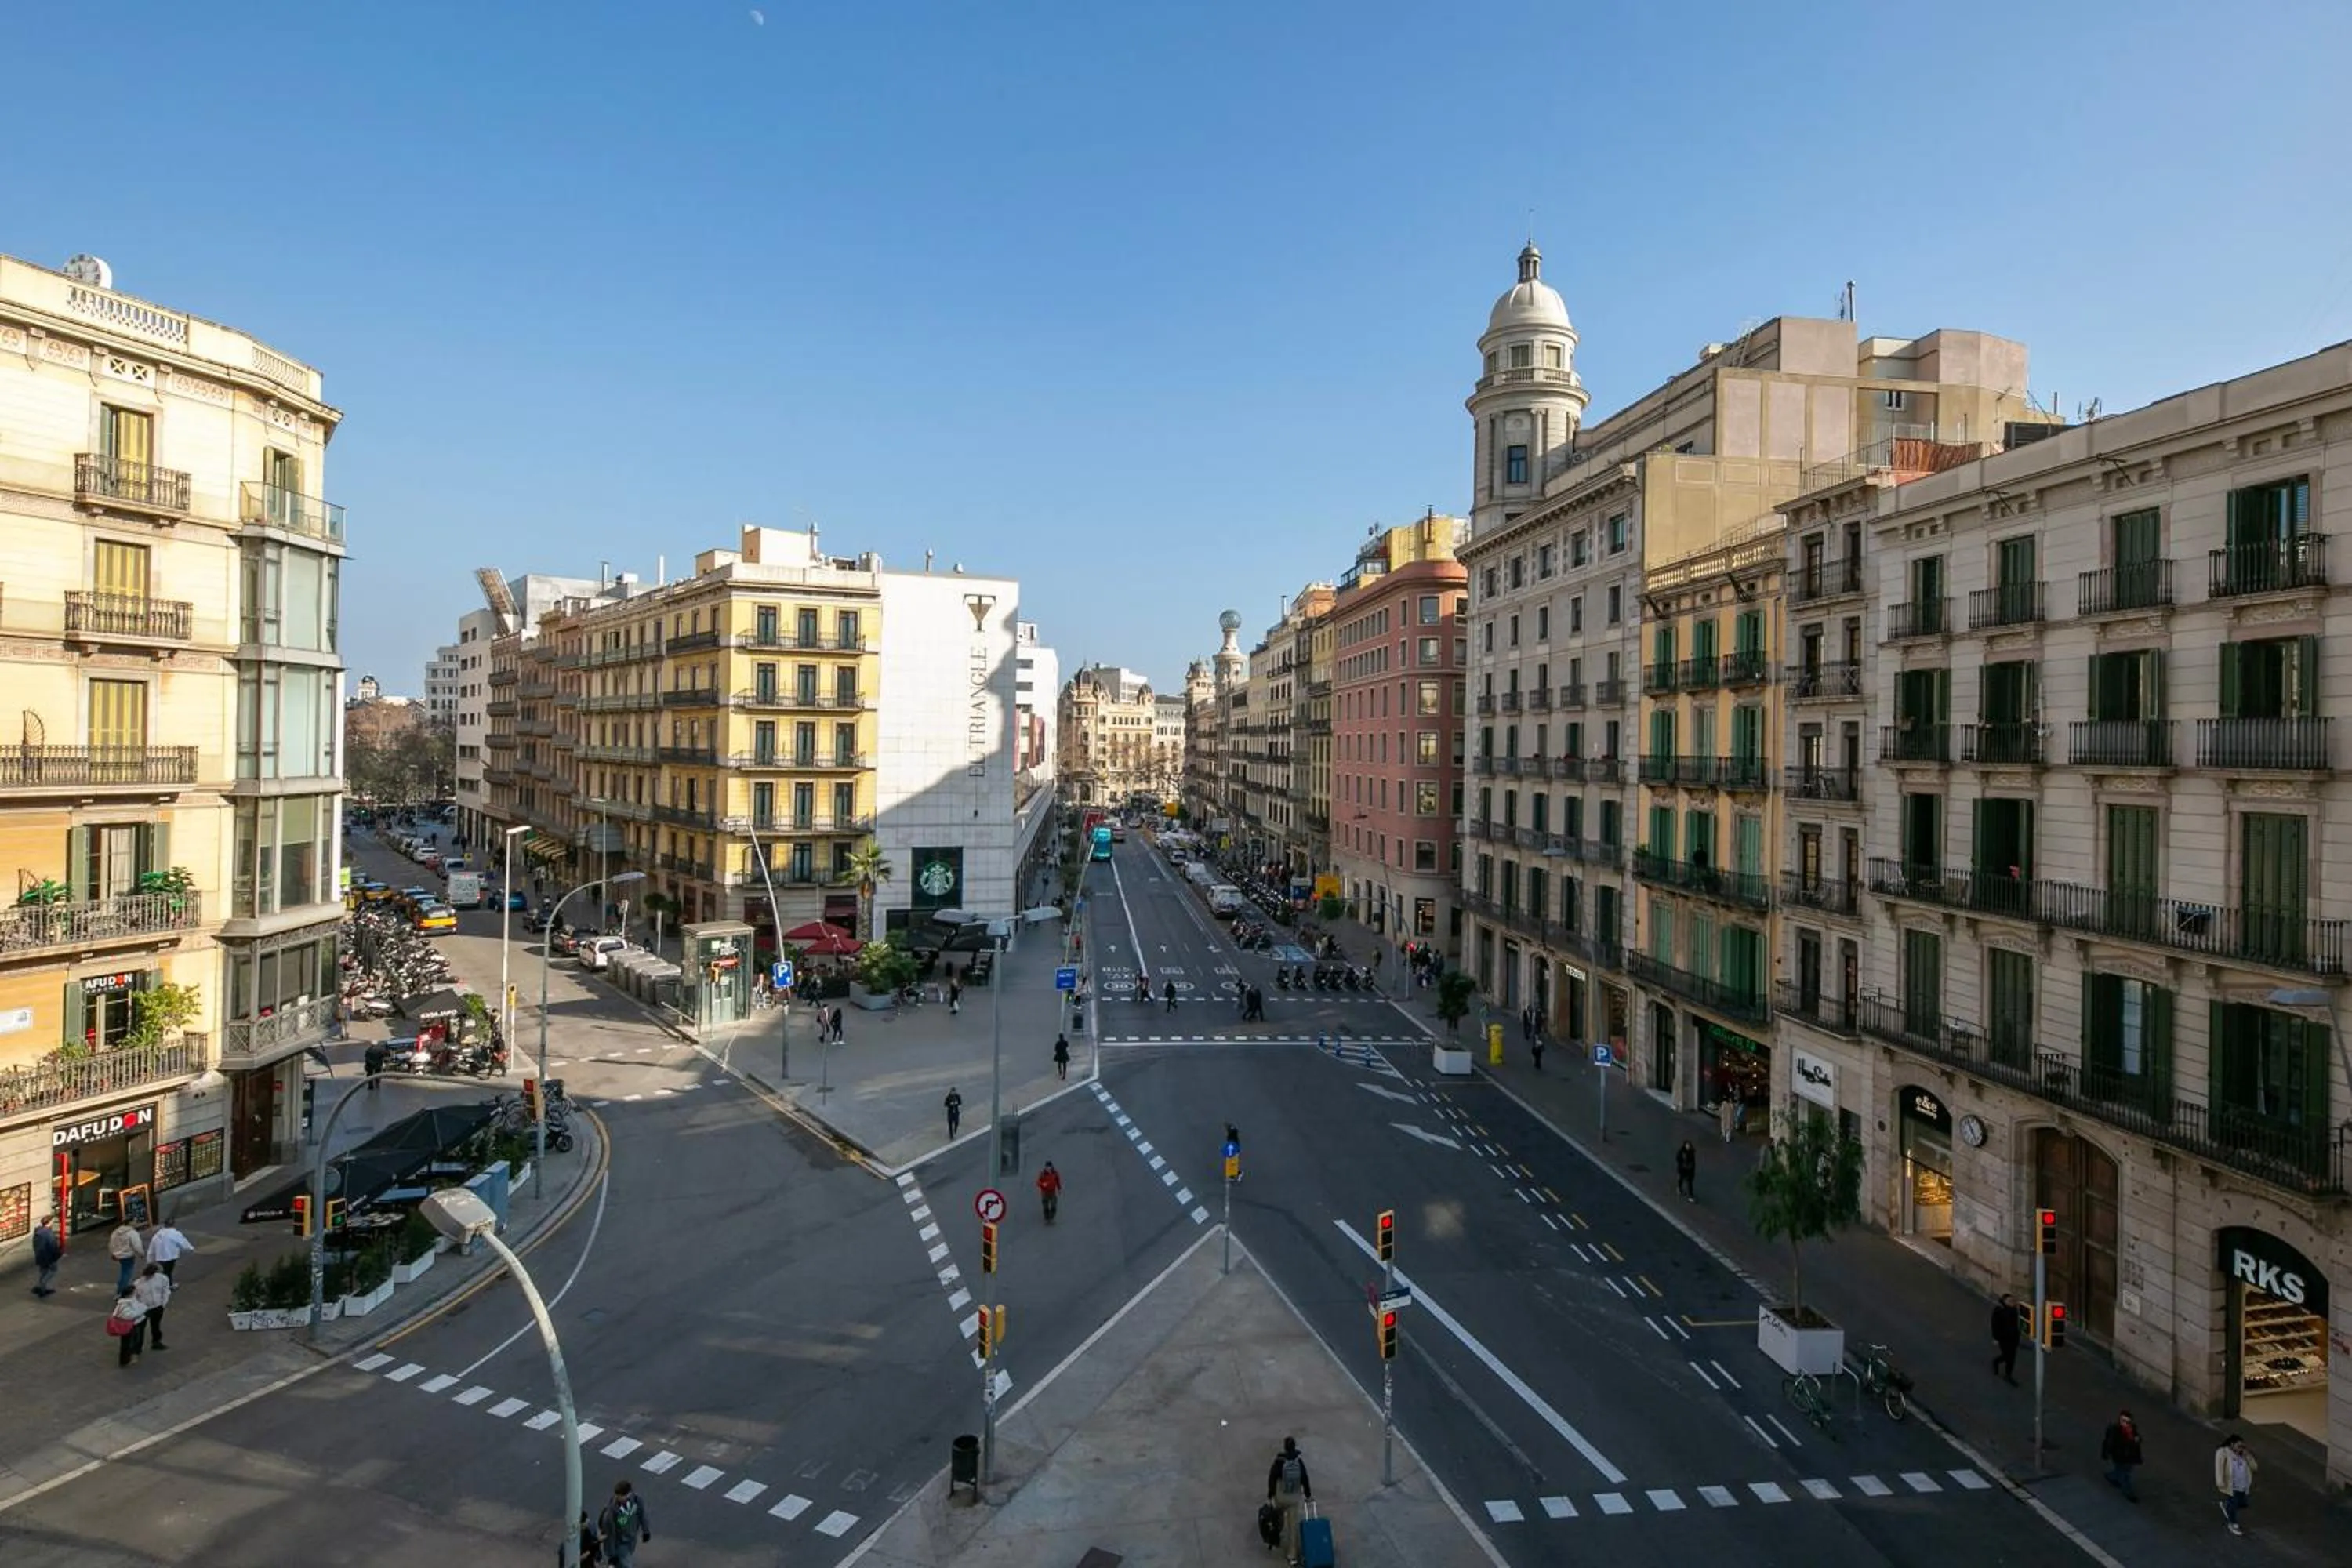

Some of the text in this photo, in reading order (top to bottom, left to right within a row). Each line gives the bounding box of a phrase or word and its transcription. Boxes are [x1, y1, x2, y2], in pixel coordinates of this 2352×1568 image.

[968, 646, 987, 777] EL TRIANGLE
[777, 965, 788, 978] P
[85, 973, 132, 989] AFUDON
[1596, 1047, 1607, 1060] P
[2233, 1247, 2305, 1305] RKS
